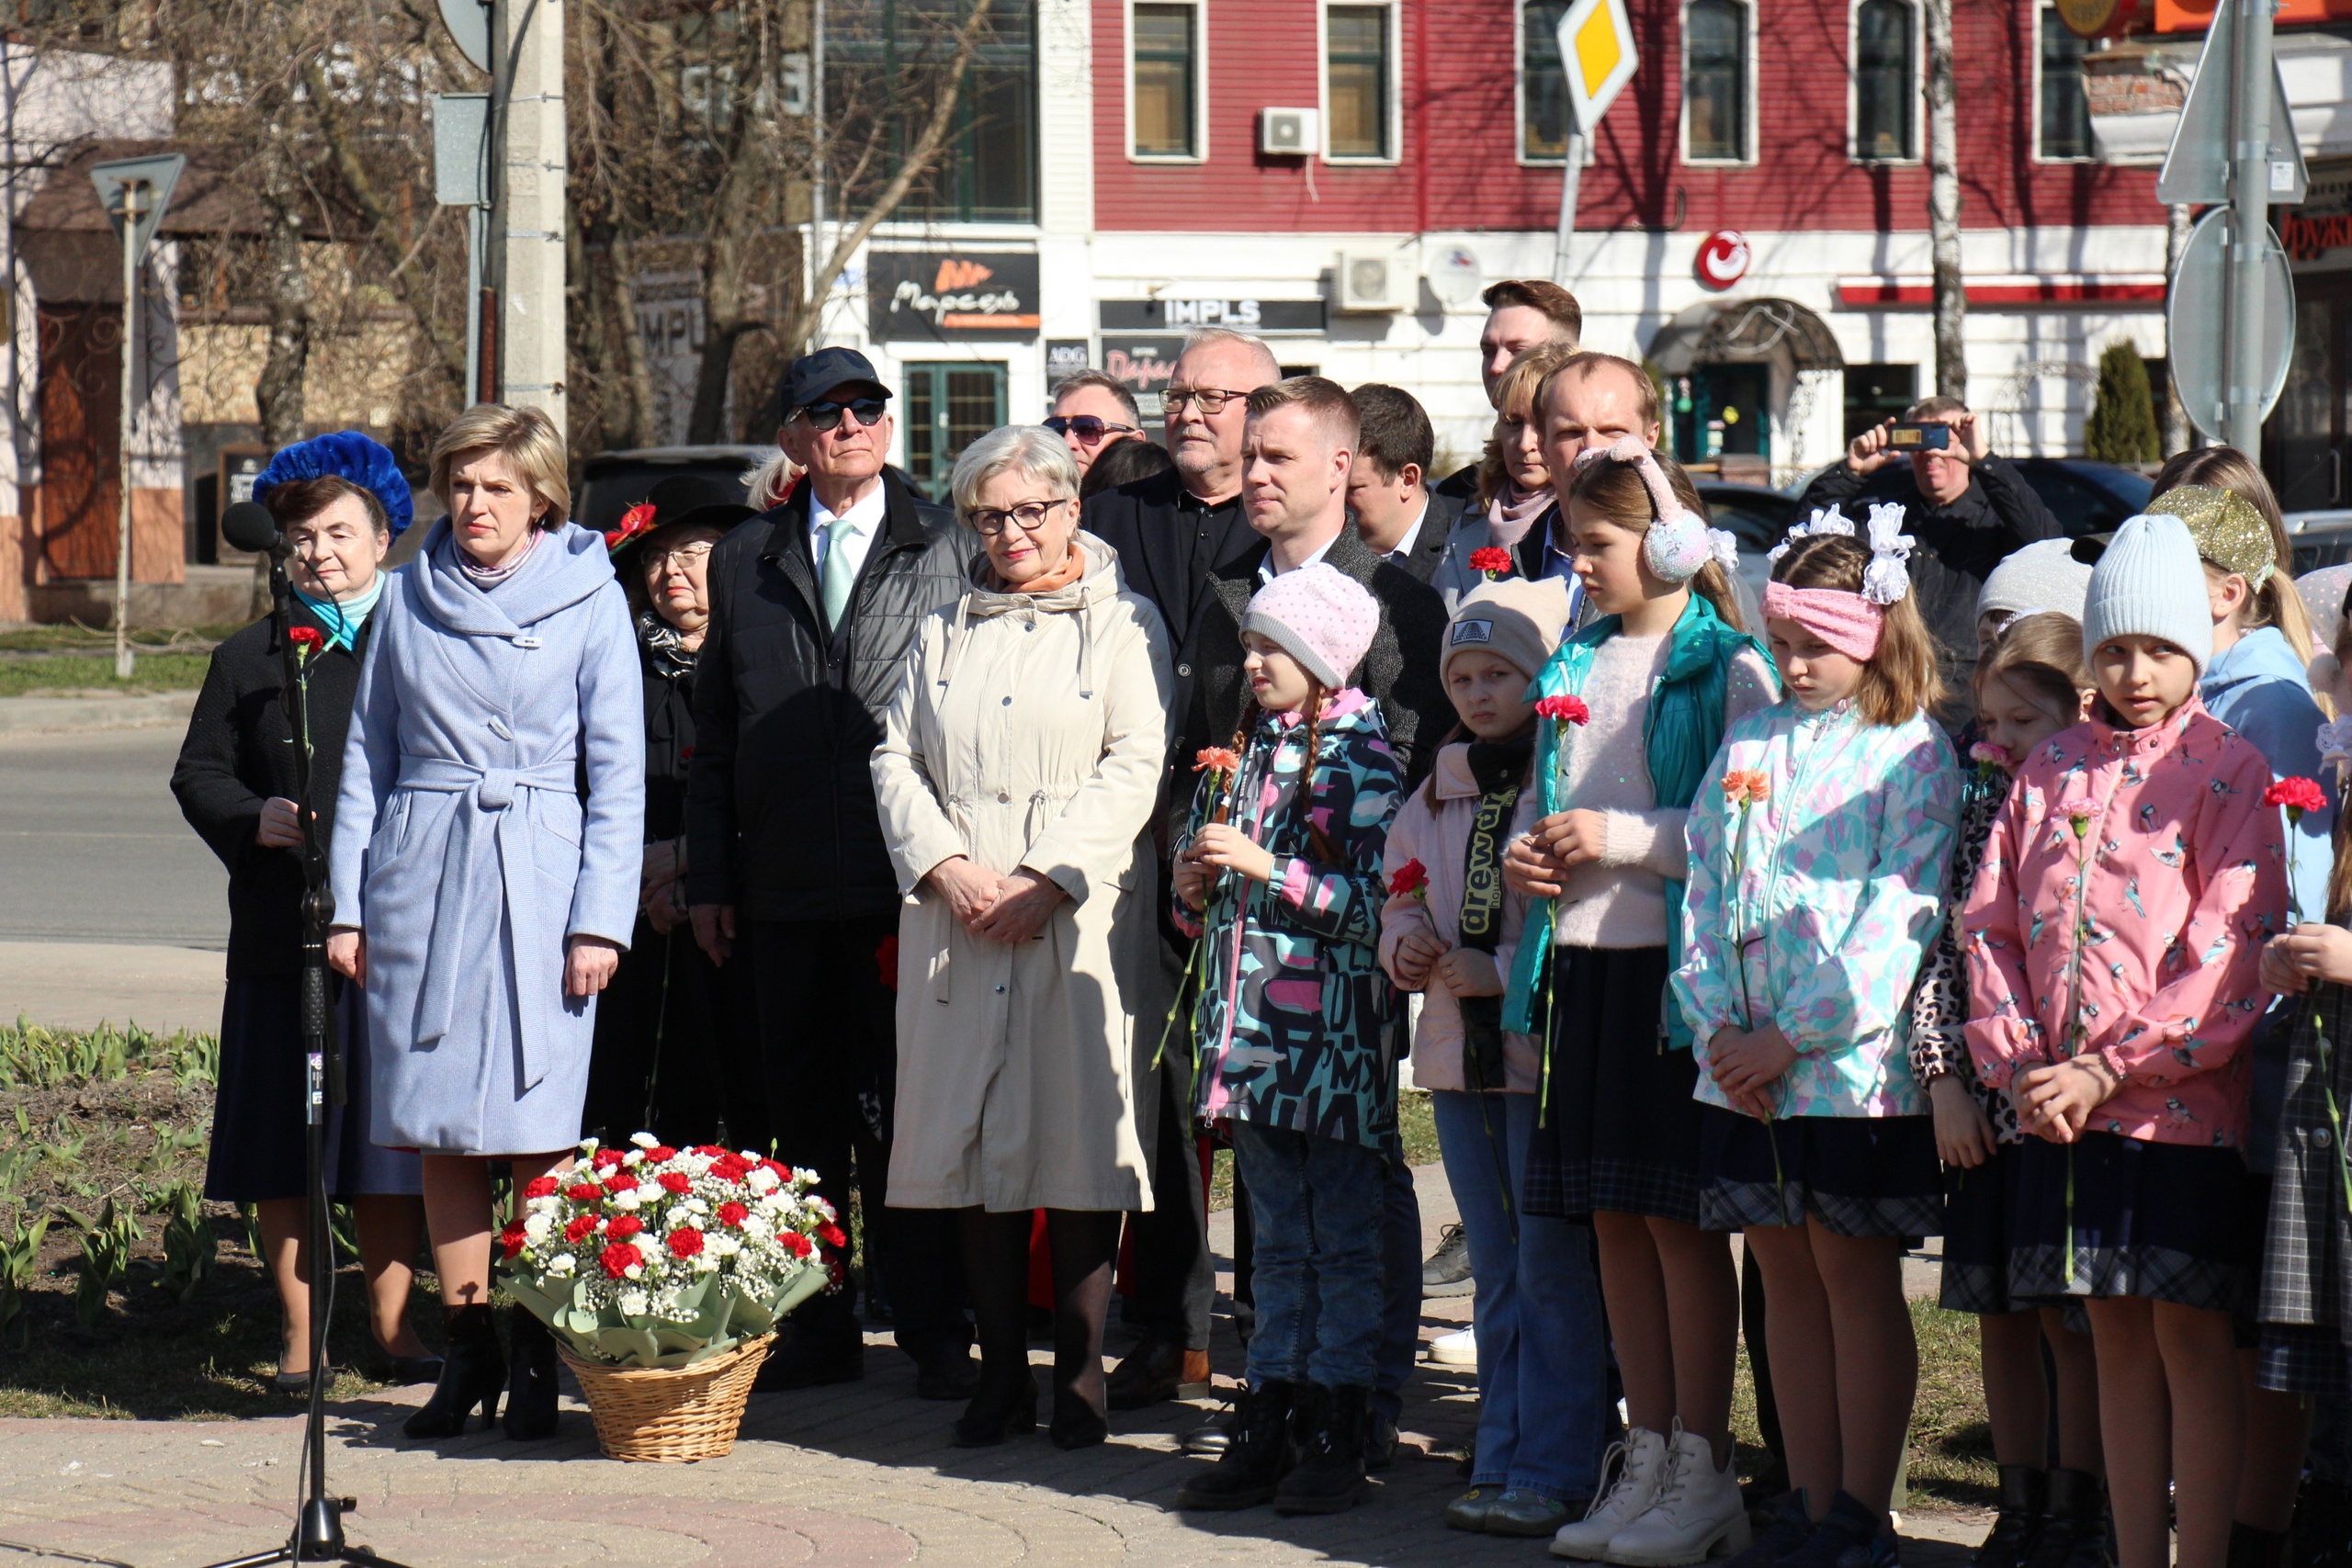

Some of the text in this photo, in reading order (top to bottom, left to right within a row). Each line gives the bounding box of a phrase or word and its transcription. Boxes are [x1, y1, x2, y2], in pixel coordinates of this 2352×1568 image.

[1164, 299, 1261, 323] IMPLS
[1047, 346, 1088, 365] ADG
[1461, 793, 1501, 934] drew dr
[1488, 867, 1502, 908] house
